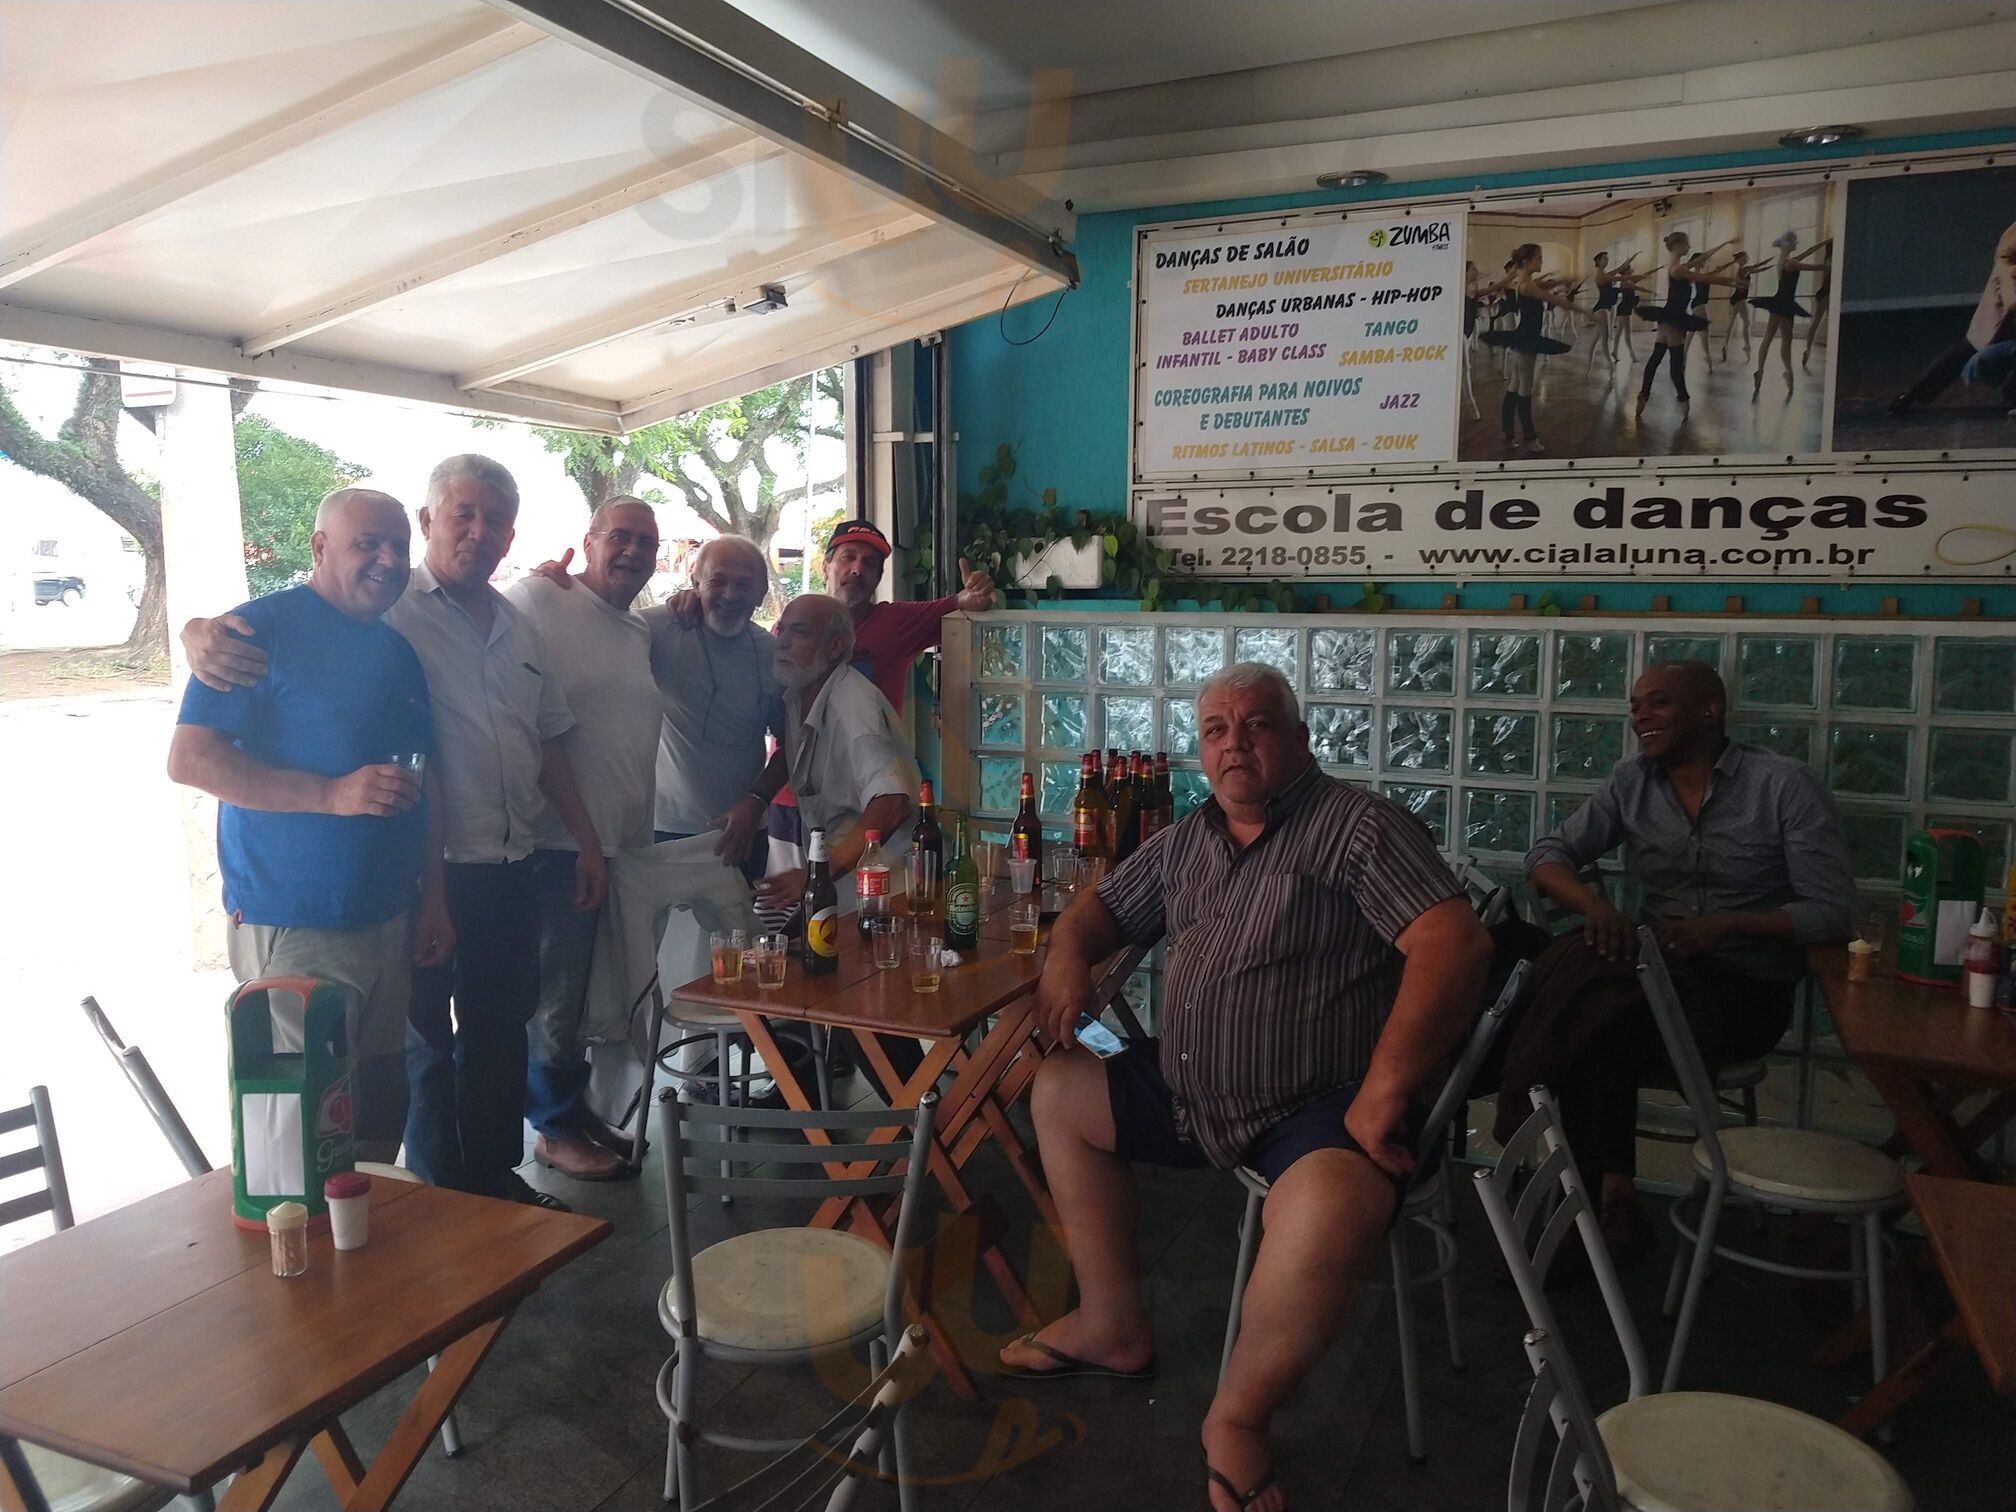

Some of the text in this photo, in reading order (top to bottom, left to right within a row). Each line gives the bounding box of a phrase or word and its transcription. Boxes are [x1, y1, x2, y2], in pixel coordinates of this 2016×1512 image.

[1388, 222, 1450, 246] ZUMBA
[1155, 236, 1310, 271] DANÇAS DE SALÃO
[1183, 261, 1393, 294] SERTANEJO UNIVERSITÁRIO
[1216, 299, 1282, 320] DANÇAS
[1282, 292, 1353, 313] URBANAS
[1372, 286, 1443, 306] HIP-HOP
[1182, 323, 1299, 346] BALLET ADULTO
[1364, 319, 1418, 337] TANGO
[1156, 351, 1221, 369] INFANTIL
[1238, 348, 1277, 364] BABY
[1282, 344, 1327, 361] CLASS
[1339, 345, 1448, 366] SAMBA-ROCK
[1154, 377, 1363, 407] COREOGRAFIA PARA NOIVOS
[1380, 393, 1421, 410] JAZZ
[1200, 408, 1310, 431] E DEBUTANTES
[1172, 443, 1228, 459] RITMOS
[1232, 440, 1295, 457] LATINOS
[1310, 436, 1356, 453] SALSA
[1373, 434, 1419, 450] ZOUK
[1146, 487, 1928, 541] Escola de danças
[1170, 547, 1212, 567] Tel.
[1221, 545, 1366, 566] 2218-0855
[1419, 543, 1875, 566] www.cialaluna.com.br
